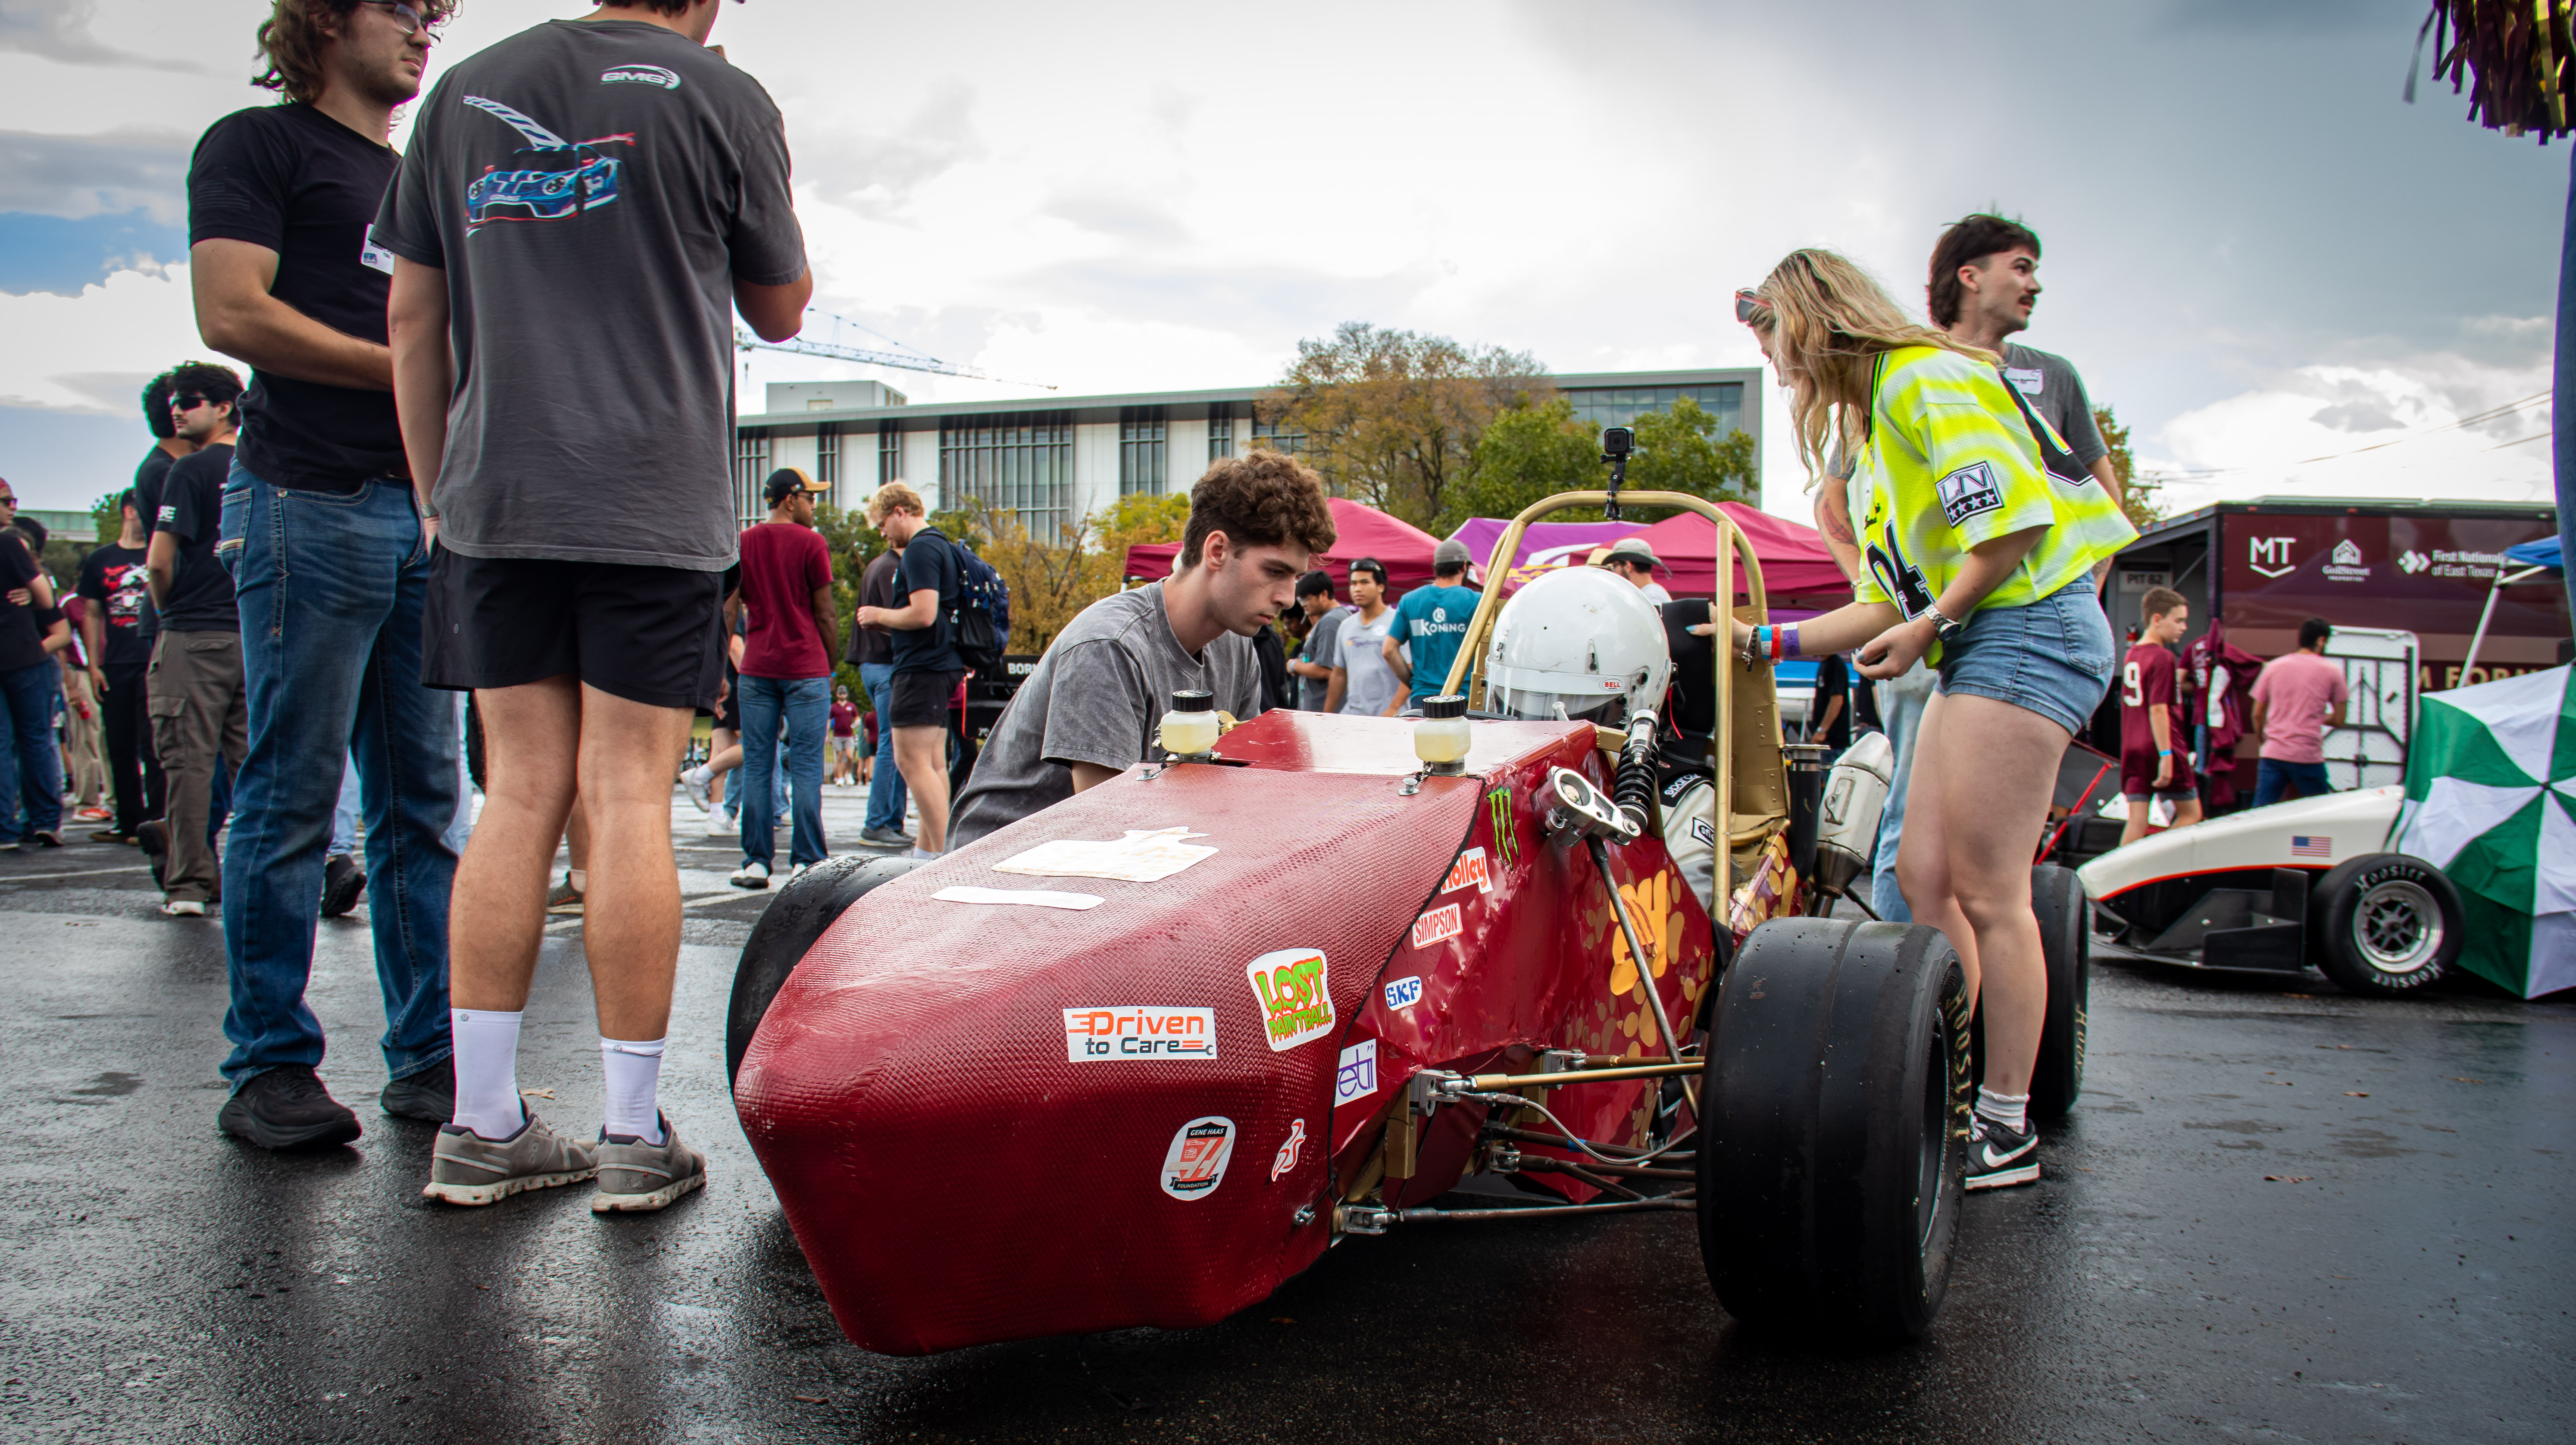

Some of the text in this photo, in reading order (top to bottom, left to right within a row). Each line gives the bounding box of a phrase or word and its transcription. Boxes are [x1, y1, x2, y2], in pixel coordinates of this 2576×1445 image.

[601, 71, 668, 85] GMG
[2250, 536, 2297, 564] MT
[2432, 550, 2504, 563] First National
[2431, 564, 2496, 577] of East Texas
[2123, 661, 2143, 707] 9
[1415, 907, 1458, 944] SIMPSON
[1254, 956, 1324, 1017] LOST
[1386, 979, 1420, 1007] SKF
[1088, 1009, 1204, 1035] Driven
[1267, 1001, 1332, 1044] PAINTBALL
[1085, 1037, 1180, 1055] to Care
